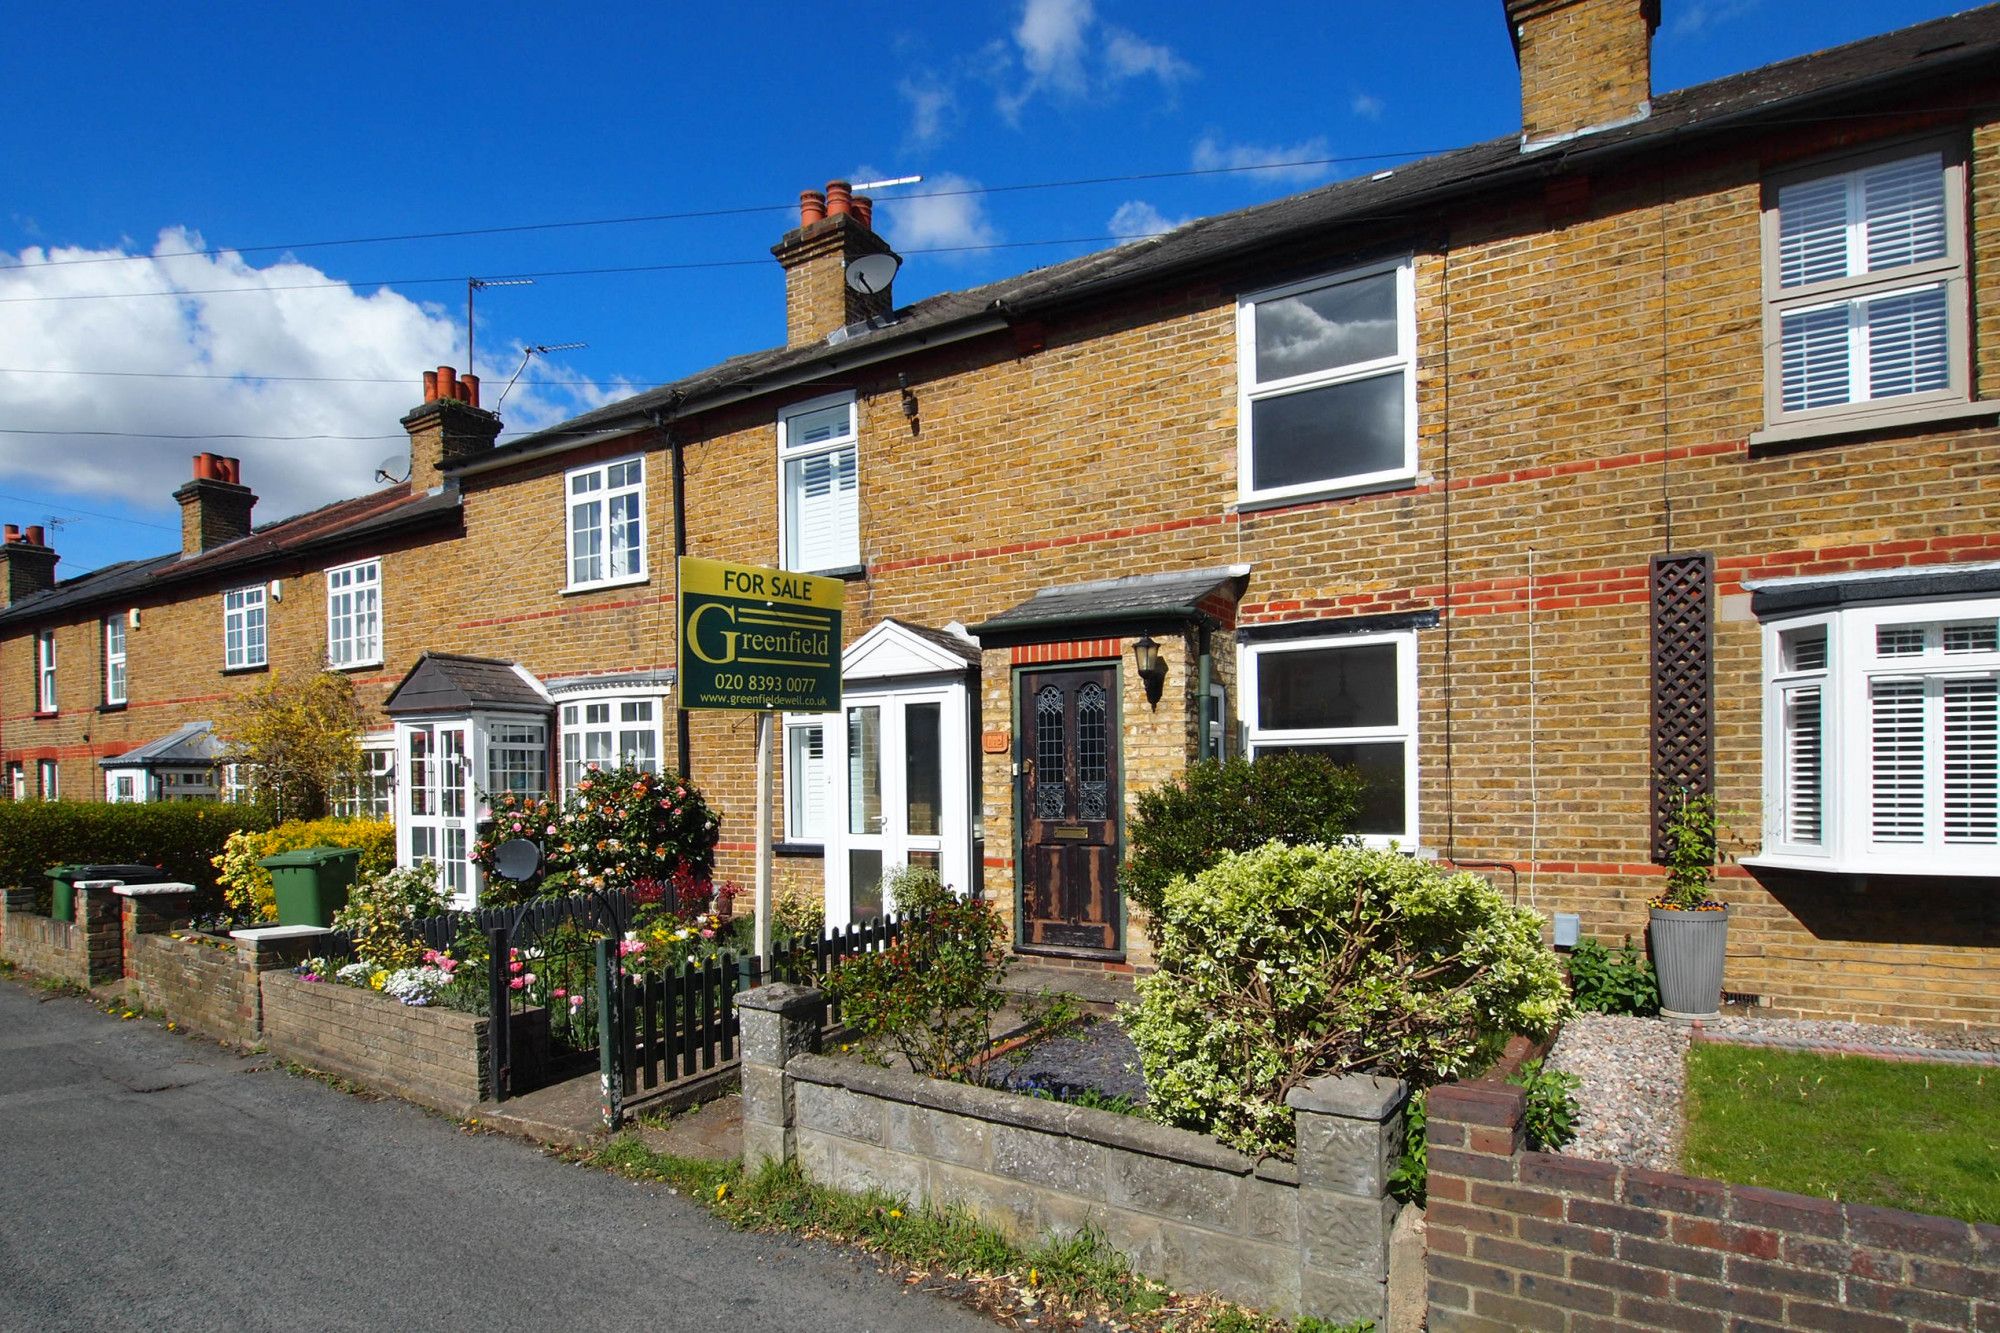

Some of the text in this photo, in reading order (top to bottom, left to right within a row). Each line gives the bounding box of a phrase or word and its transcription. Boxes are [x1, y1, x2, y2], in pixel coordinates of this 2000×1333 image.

[724, 571, 812, 600] FOR SALE
[687, 603, 829, 664] Greenfield
[715, 674, 816, 692] 020 8393 0077
[700, 693, 827, 706] www.greenfieldewell.co.uk
